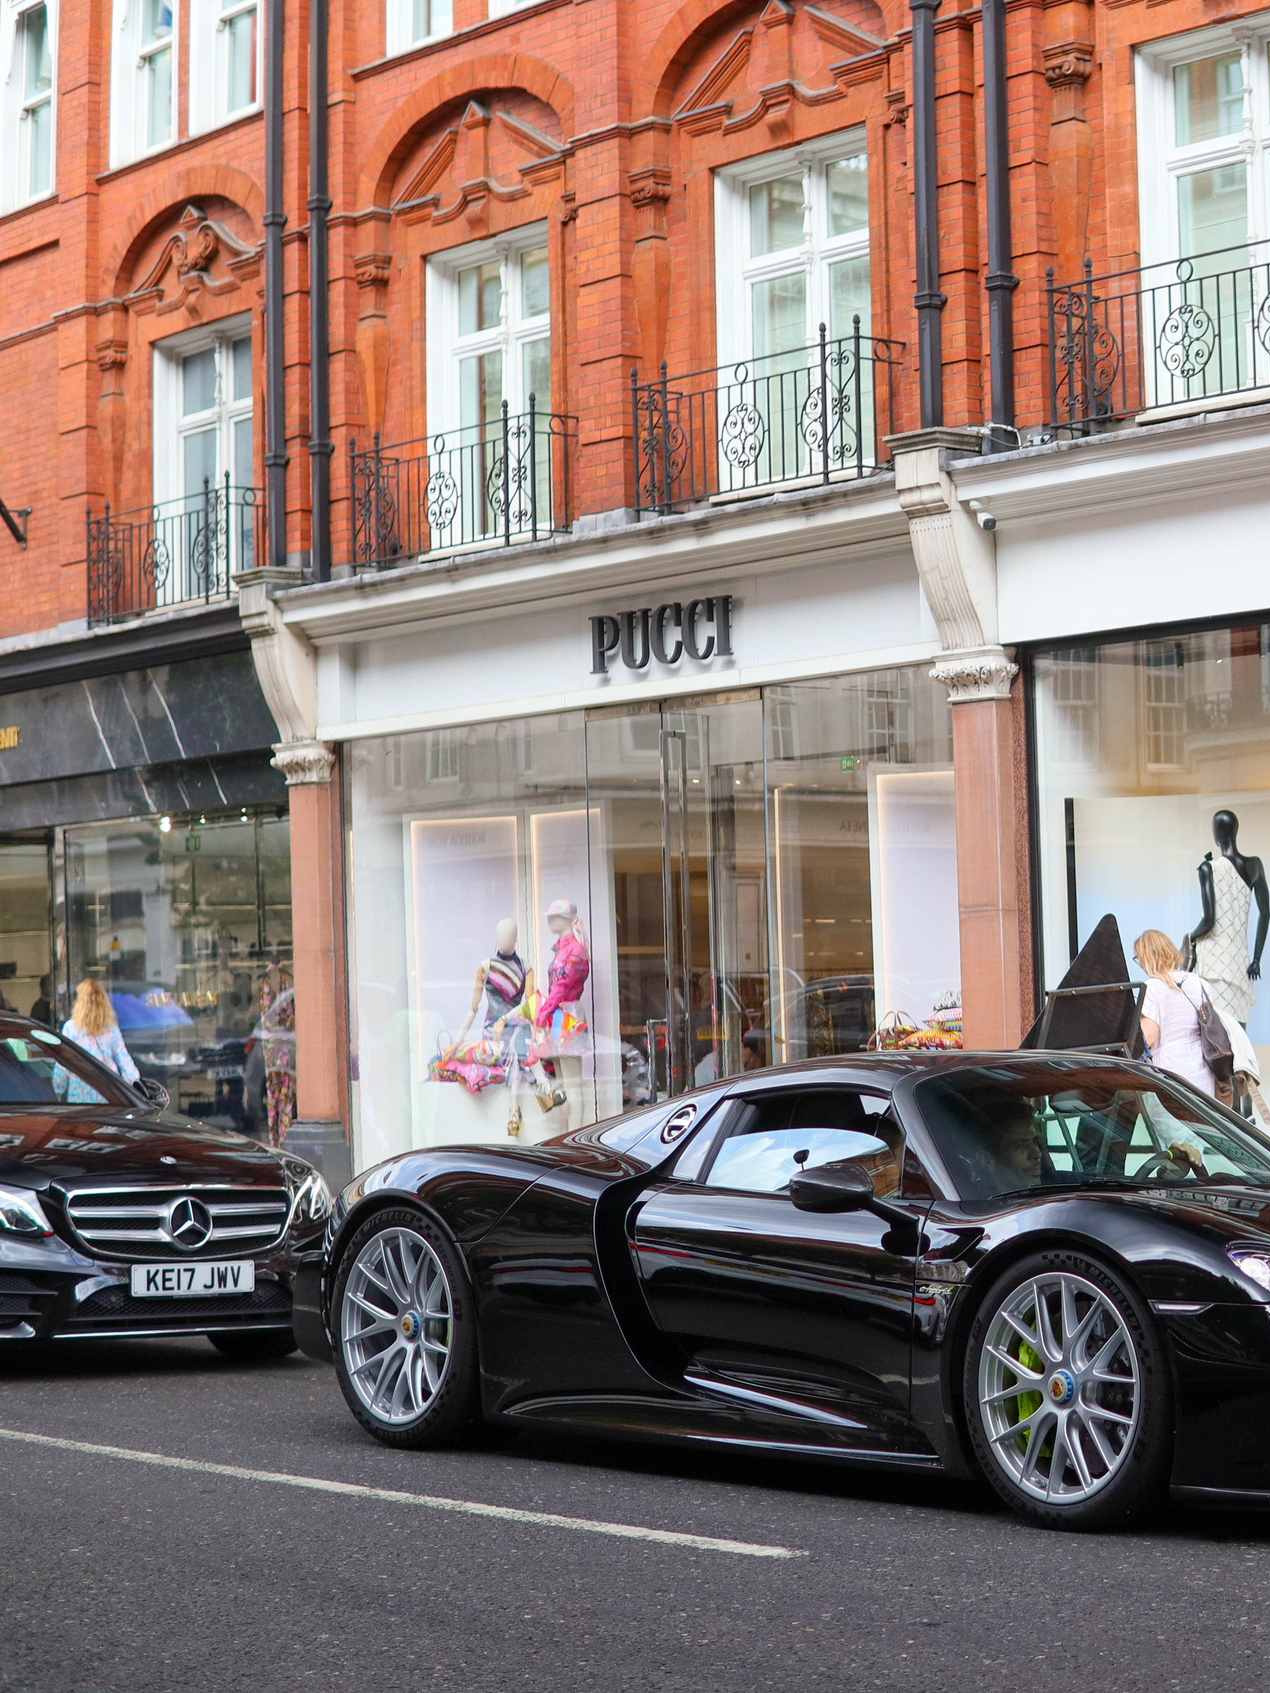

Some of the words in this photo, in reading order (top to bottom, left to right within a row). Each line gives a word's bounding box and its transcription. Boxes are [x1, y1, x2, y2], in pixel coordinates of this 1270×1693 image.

[588, 595, 734, 674] PUCCI
[361, 1210, 413, 1234] MICHELIN
[146, 1268, 196, 1292] KE17
[203, 1265, 241, 1290] JWV
[1087, 1265, 1139, 1330] MICHELIN
